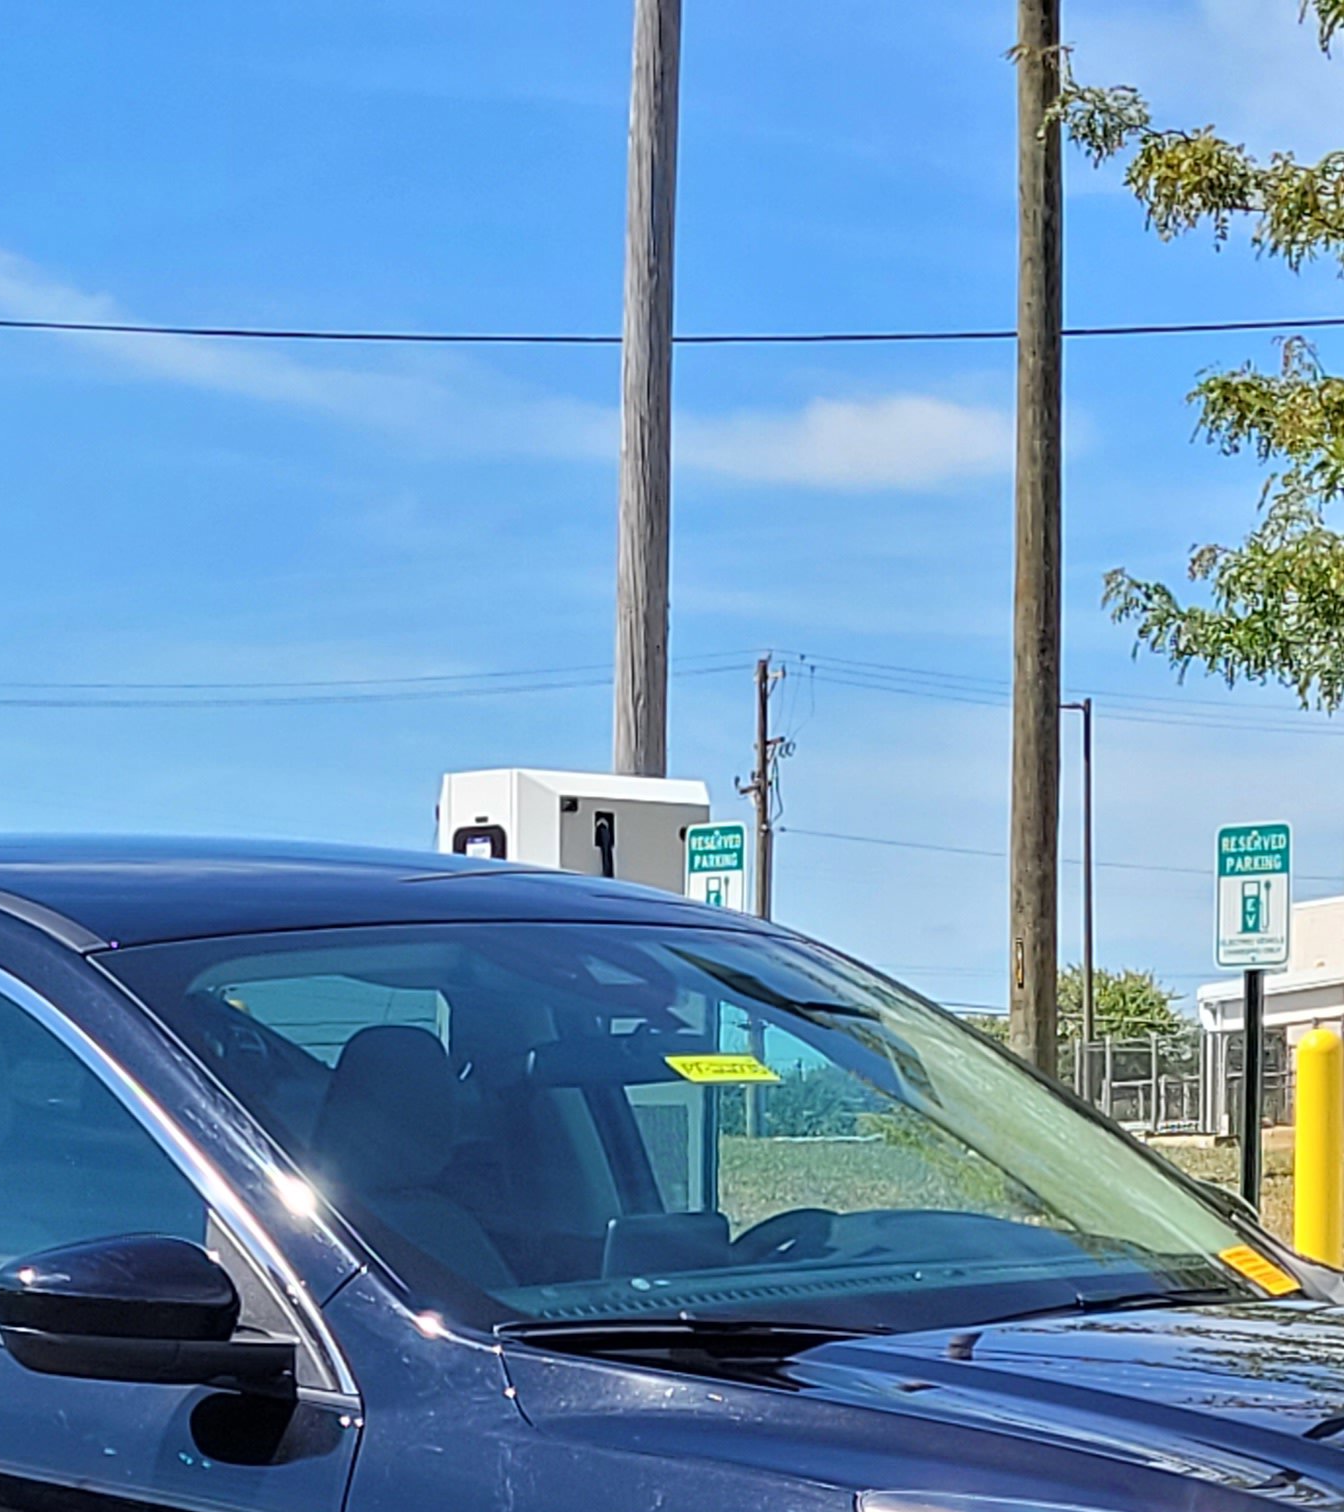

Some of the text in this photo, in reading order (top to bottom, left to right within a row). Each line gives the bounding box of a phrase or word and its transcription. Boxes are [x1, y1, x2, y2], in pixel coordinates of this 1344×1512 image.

[691, 834, 741, 850] RESERVED
[1221, 834, 1286, 853] RESERVED
[694, 853, 738, 869] PARKING
[1226, 854, 1281, 872] PARKING
